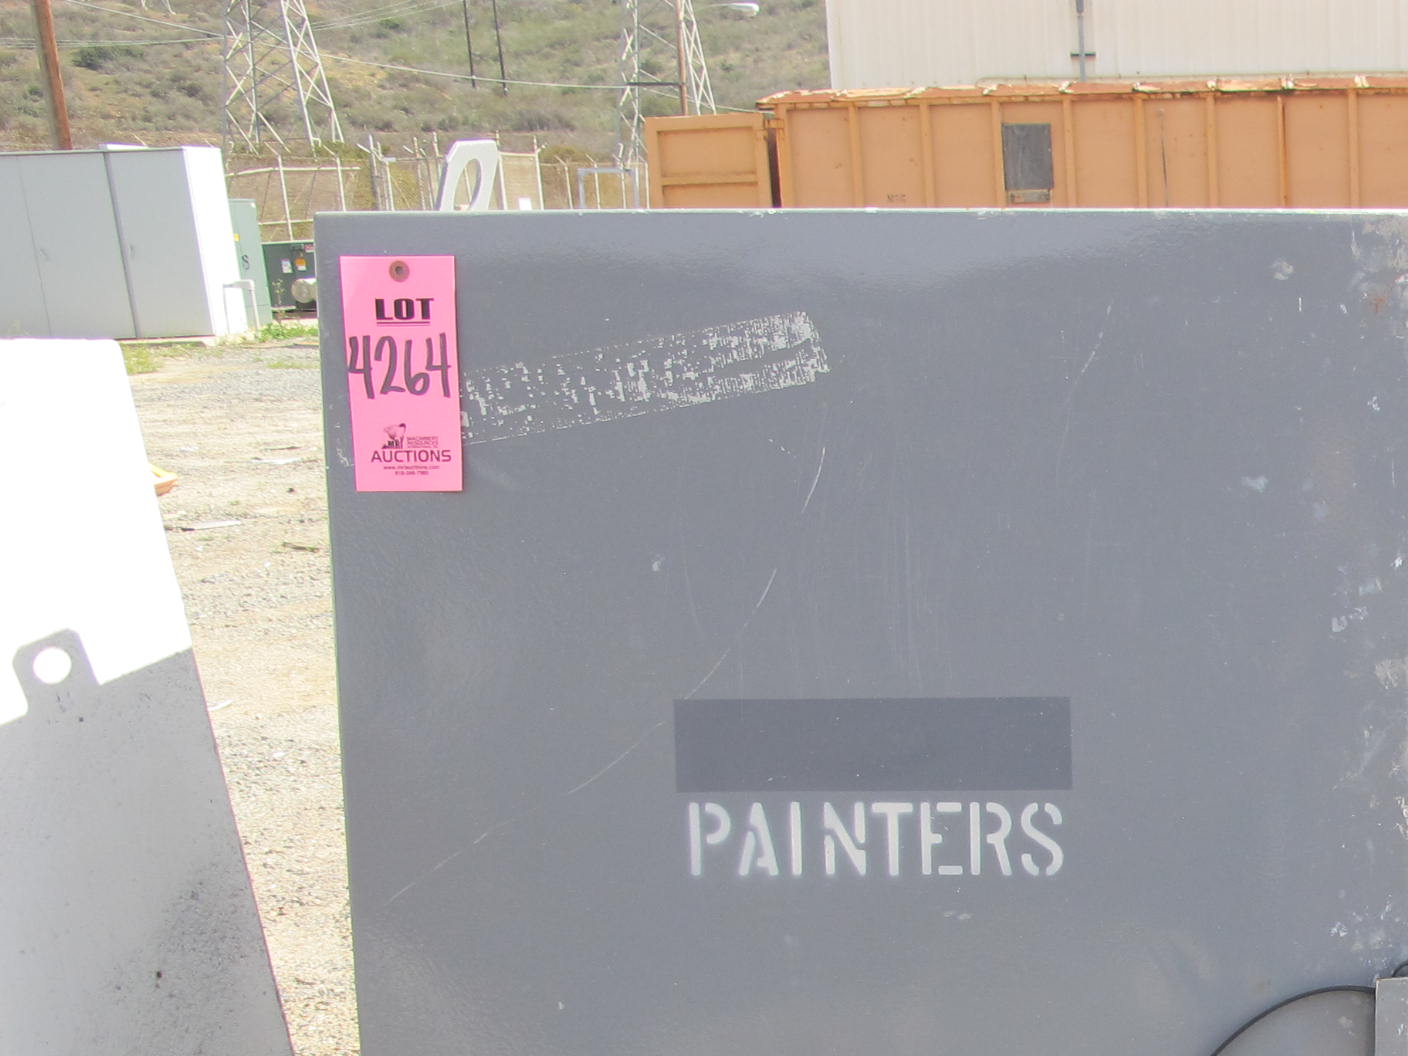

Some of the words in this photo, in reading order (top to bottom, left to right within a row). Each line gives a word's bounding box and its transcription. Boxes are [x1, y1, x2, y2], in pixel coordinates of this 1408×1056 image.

[375, 298, 434, 320] LOT
[346, 332, 451, 399] 4264
[371, 449, 452, 463] AUCTIONS
[689, 801, 1064, 876] PAINTERS
